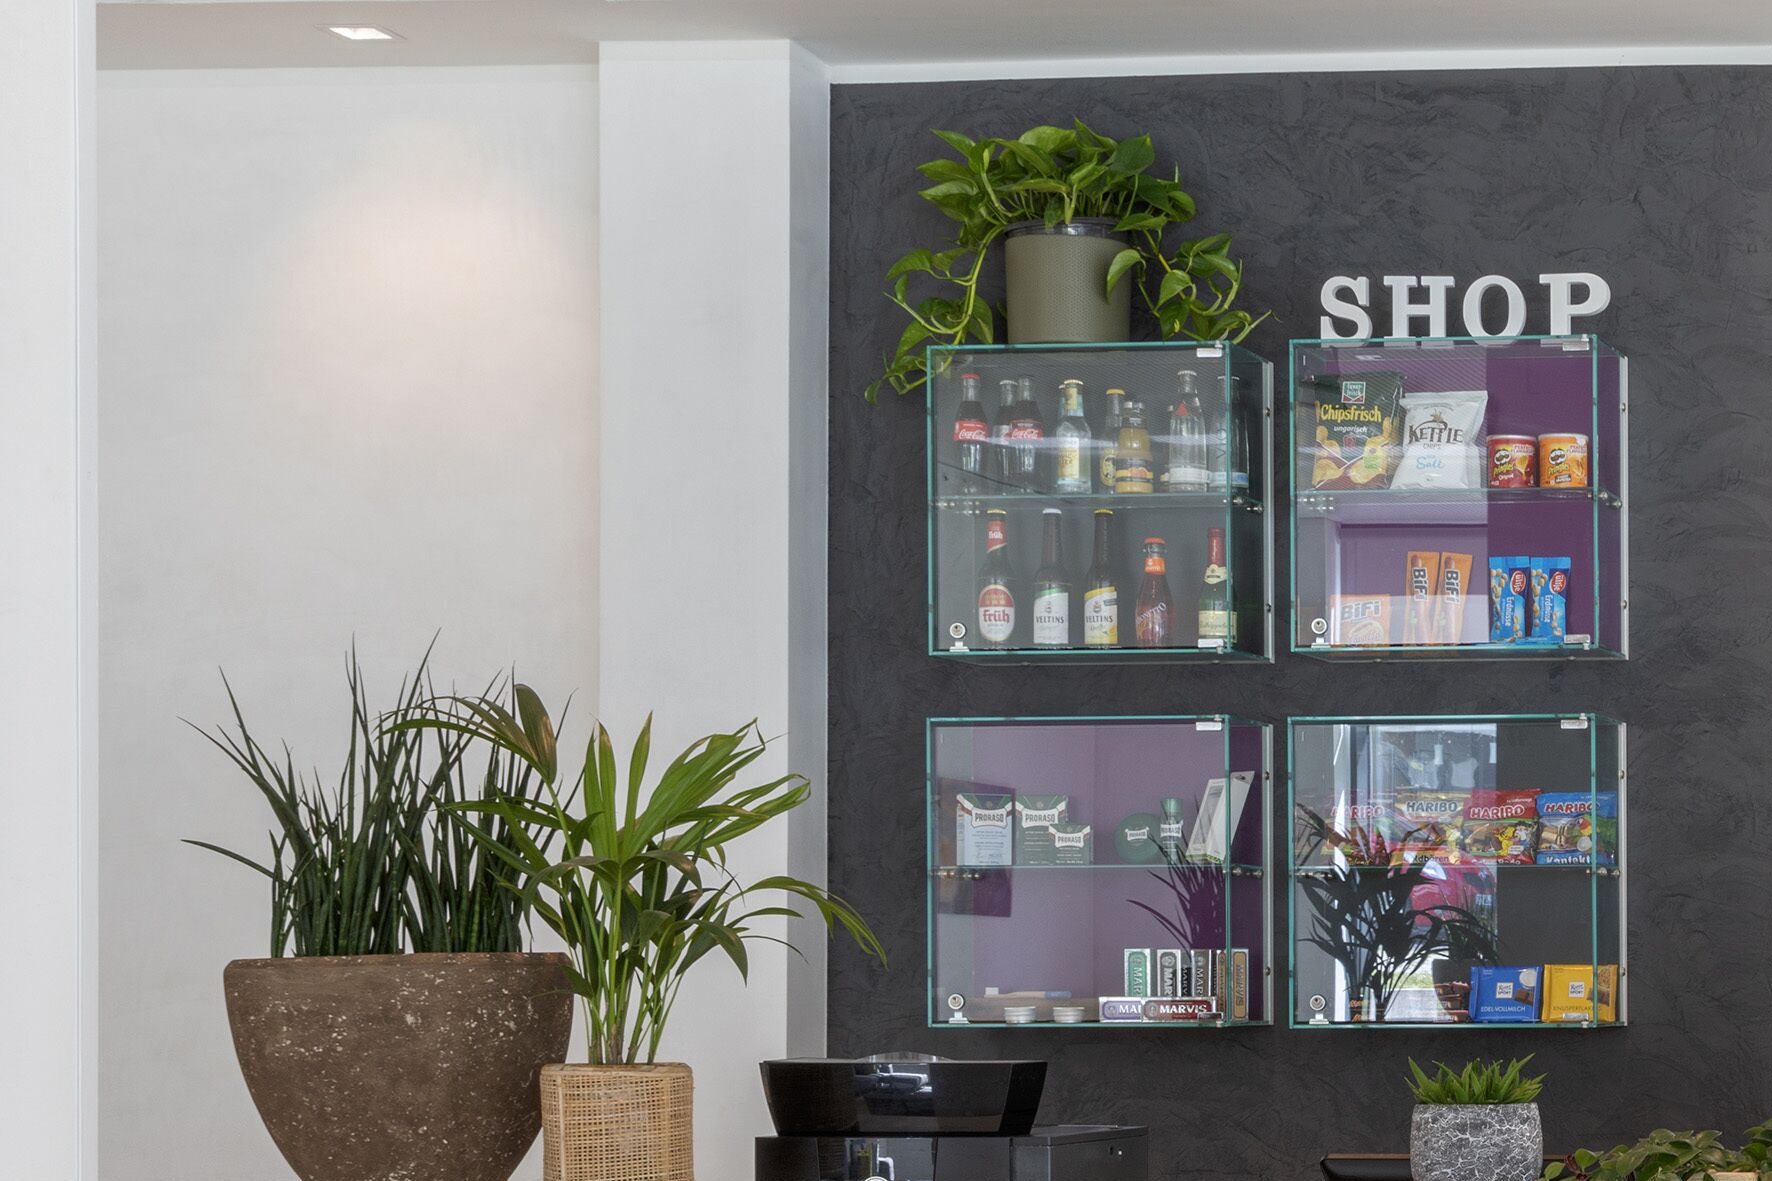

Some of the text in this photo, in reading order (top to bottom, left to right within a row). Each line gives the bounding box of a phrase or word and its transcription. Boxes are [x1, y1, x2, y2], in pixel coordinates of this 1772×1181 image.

[1320, 272, 1612, 349] SHOP
[1320, 404, 1382, 422] Chipsfrisch
[1333, 425, 1368, 433] ungarisch
[1408, 423, 1464, 445] KETTLE
[1416, 457, 1443, 470] Salt
[1413, 567, 1428, 601] BiFi
[982, 609, 1010, 624] früh
[1505, 596, 1515, 627] Erdnüsse
[1036, 615, 1065, 624] VELTINS
[1085, 615, 1113, 623] VELTINS
[1406, 800, 1459, 813] HARIBO
[1470, 804, 1525, 820] HARIBO
[1544, 801, 1601, 814] HARIBO
[974, 813, 1005, 824] PRORASO
[1024, 813, 1056, 824] PRORASO
[1057, 836, 1082, 844] PRORASO
[1133, 966, 1143, 996] MAR
[1163, 967, 1174, 997] MAR
[1196, 967, 1205, 997] MAR
[1159, 1004, 1208, 1014] MARVIS
